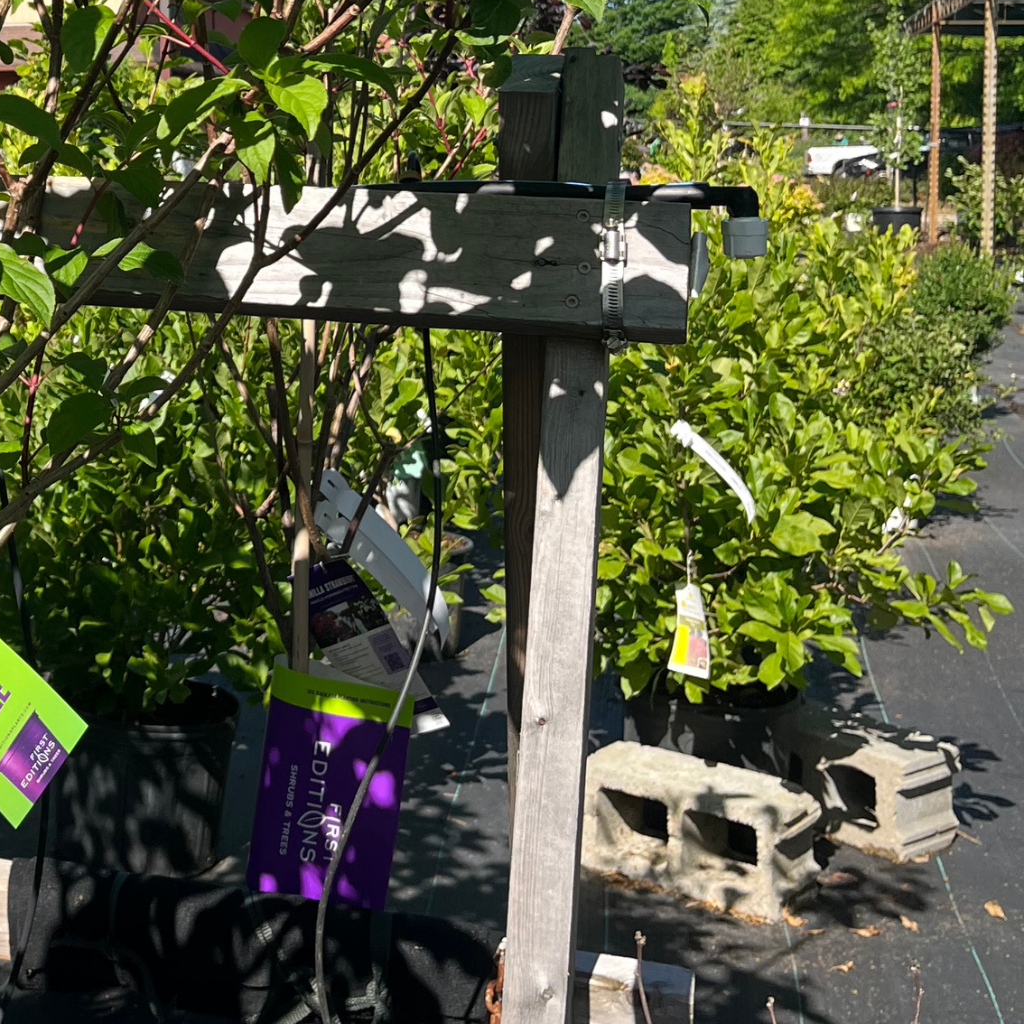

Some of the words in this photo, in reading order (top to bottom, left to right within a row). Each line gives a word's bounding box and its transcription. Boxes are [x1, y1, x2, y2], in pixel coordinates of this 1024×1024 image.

[19, 739, 57, 789] EDITIONS
[29, 732, 49, 761] FIRST
[285, 764, 298, 808] SHRUBS
[297, 740, 332, 862] EDITIONS
[283, 810, 292, 818] &
[278, 821, 291, 856] TREES
